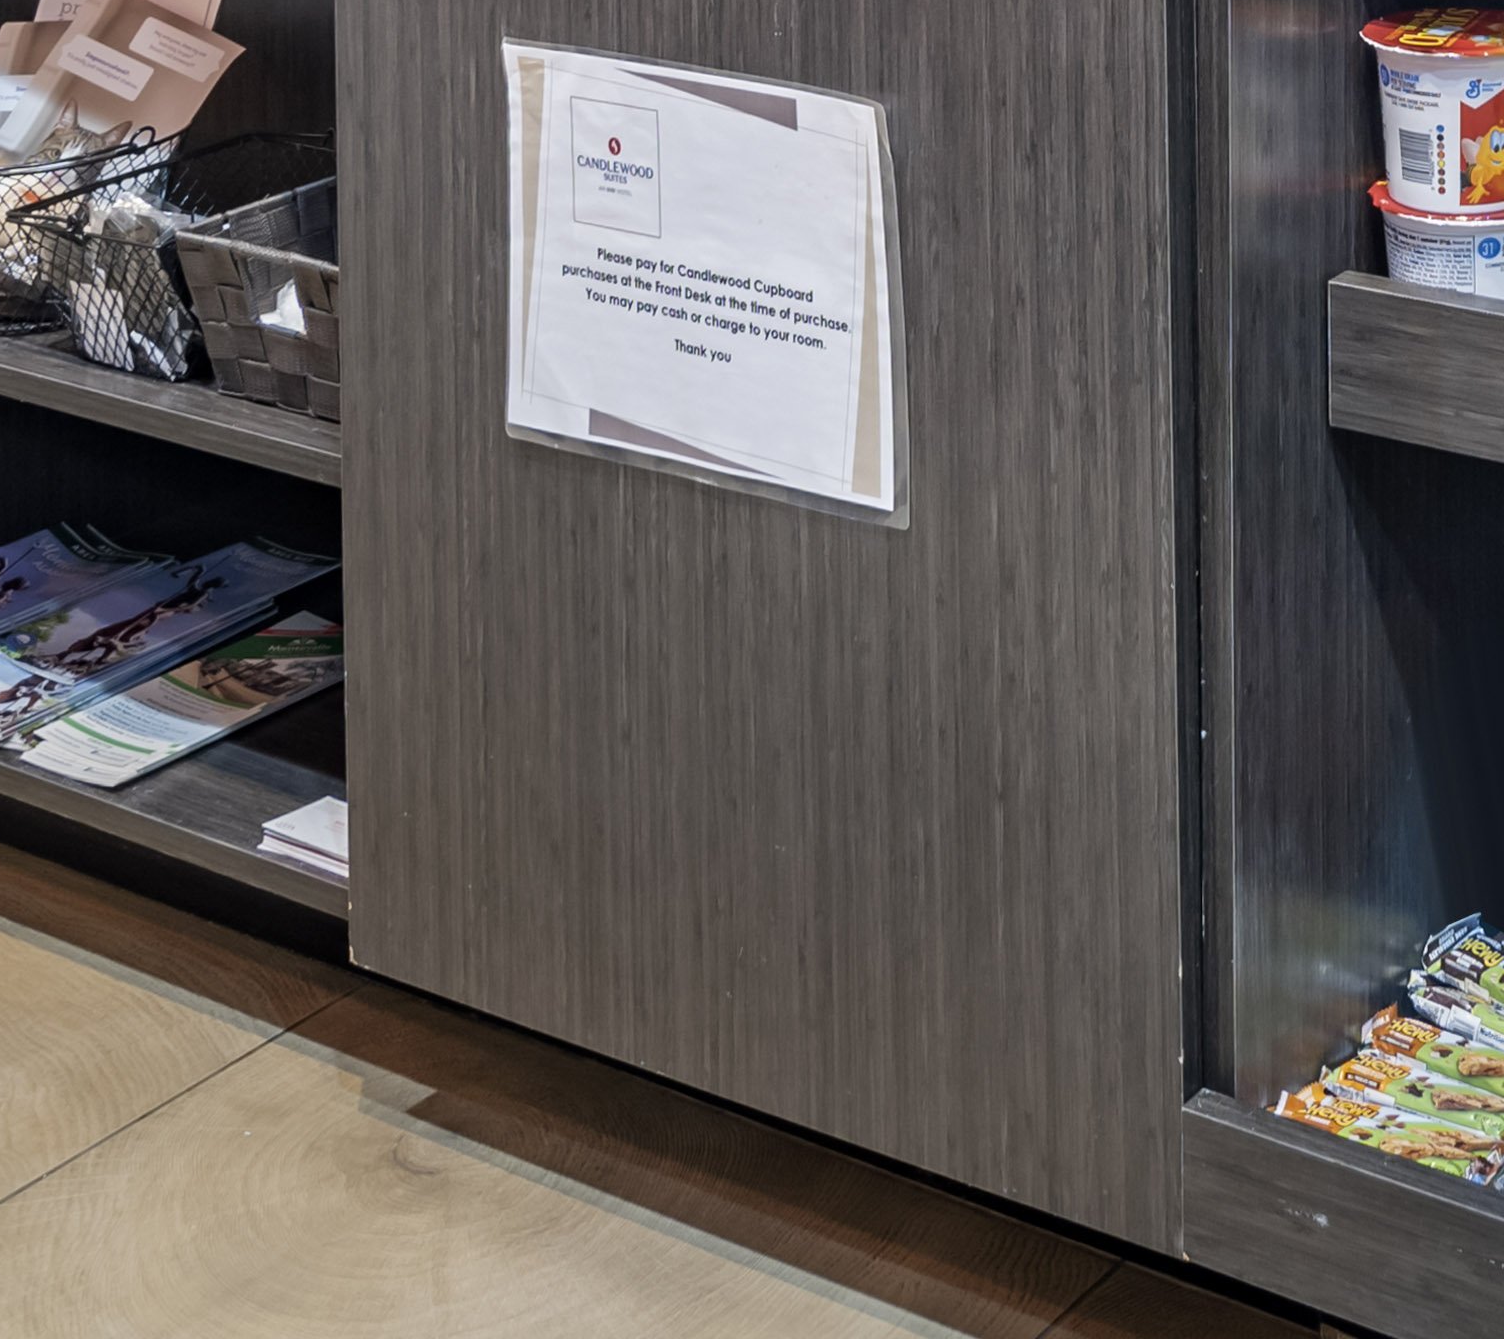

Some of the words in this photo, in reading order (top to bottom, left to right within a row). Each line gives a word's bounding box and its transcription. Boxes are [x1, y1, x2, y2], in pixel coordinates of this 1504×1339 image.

[577, 155, 654, 181] CANDLEWOOD
[603, 173, 628, 185] SUITES
[597, 248, 633, 267] Please
[636, 258, 657, 275] pay
[659, 260, 675, 276] for
[677, 264, 751, 292] Candlewood
[754, 279, 813, 304] Cupboard
[562, 264, 618, 287] purchases
[621, 274, 632, 287] at
[634, 277, 652, 292] the
[655, 281, 682, 299] Front
[685, 288, 712, 306] Desk
[715, 294, 726, 307] at
[729, 296, 747, 312] the
[750, 300, 776, 320] time
[779, 304, 791, 320] of
[794, 309, 852, 335] purchase.
[585, 287, 606, 305] You
[609, 294, 633, 312] may
[636, 301, 658, 319] pay
[661, 305, 688, 324] cash
[690, 313, 702, 325] or
[704, 315, 746, 335] charge
[749, 322, 760, 337] to
[763, 327, 789, 344] your
[792, 332, 828, 351] room.
[674, 339, 707, 361] Thank
[709, 347, 732, 364] you
